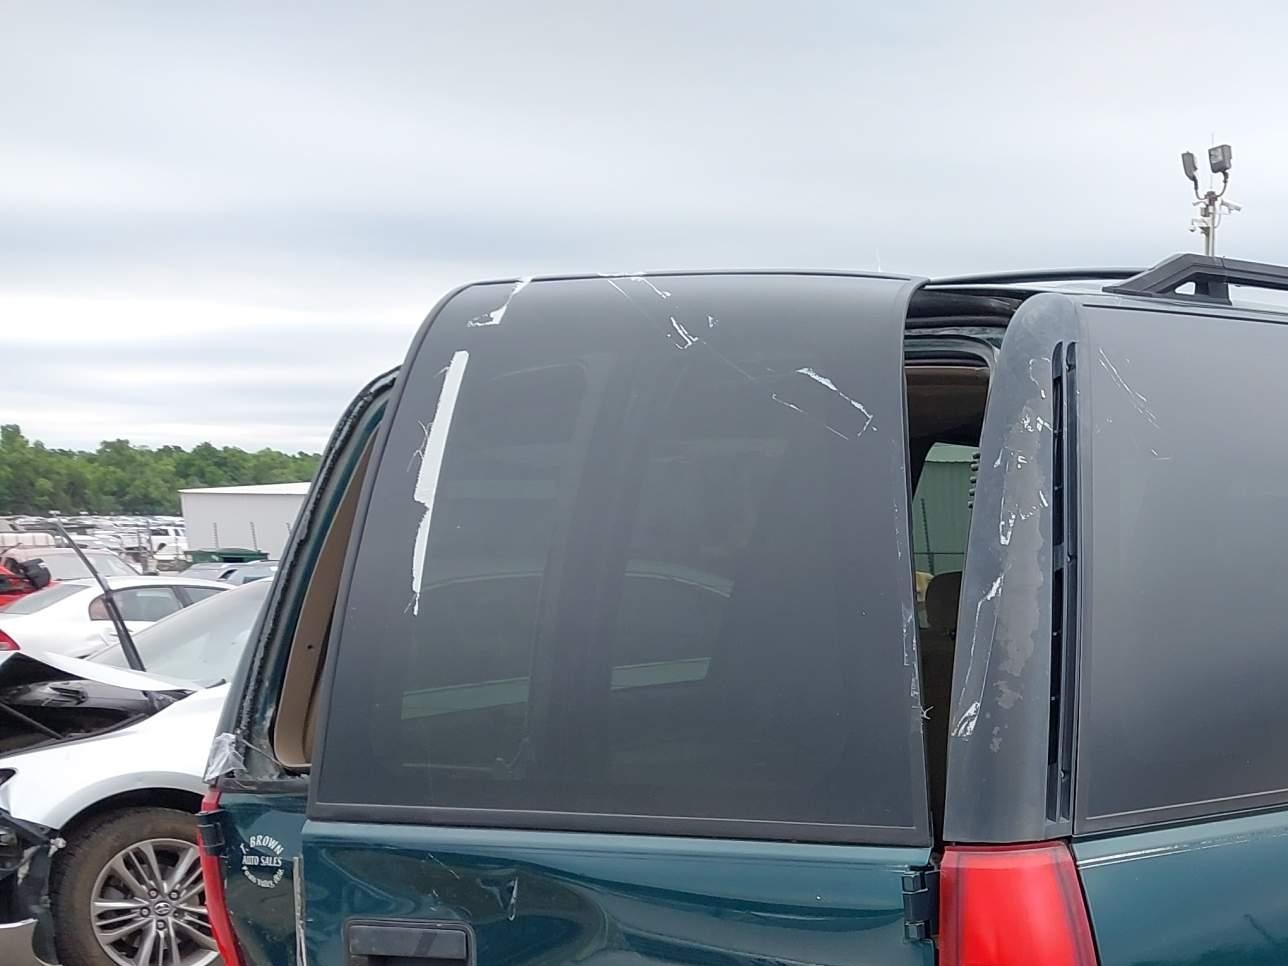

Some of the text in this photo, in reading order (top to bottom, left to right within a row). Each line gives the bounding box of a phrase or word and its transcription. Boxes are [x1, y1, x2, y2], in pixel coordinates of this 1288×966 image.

[249, 835, 284, 855] BROWN
[242, 855, 282, 867] AUTO SALES
